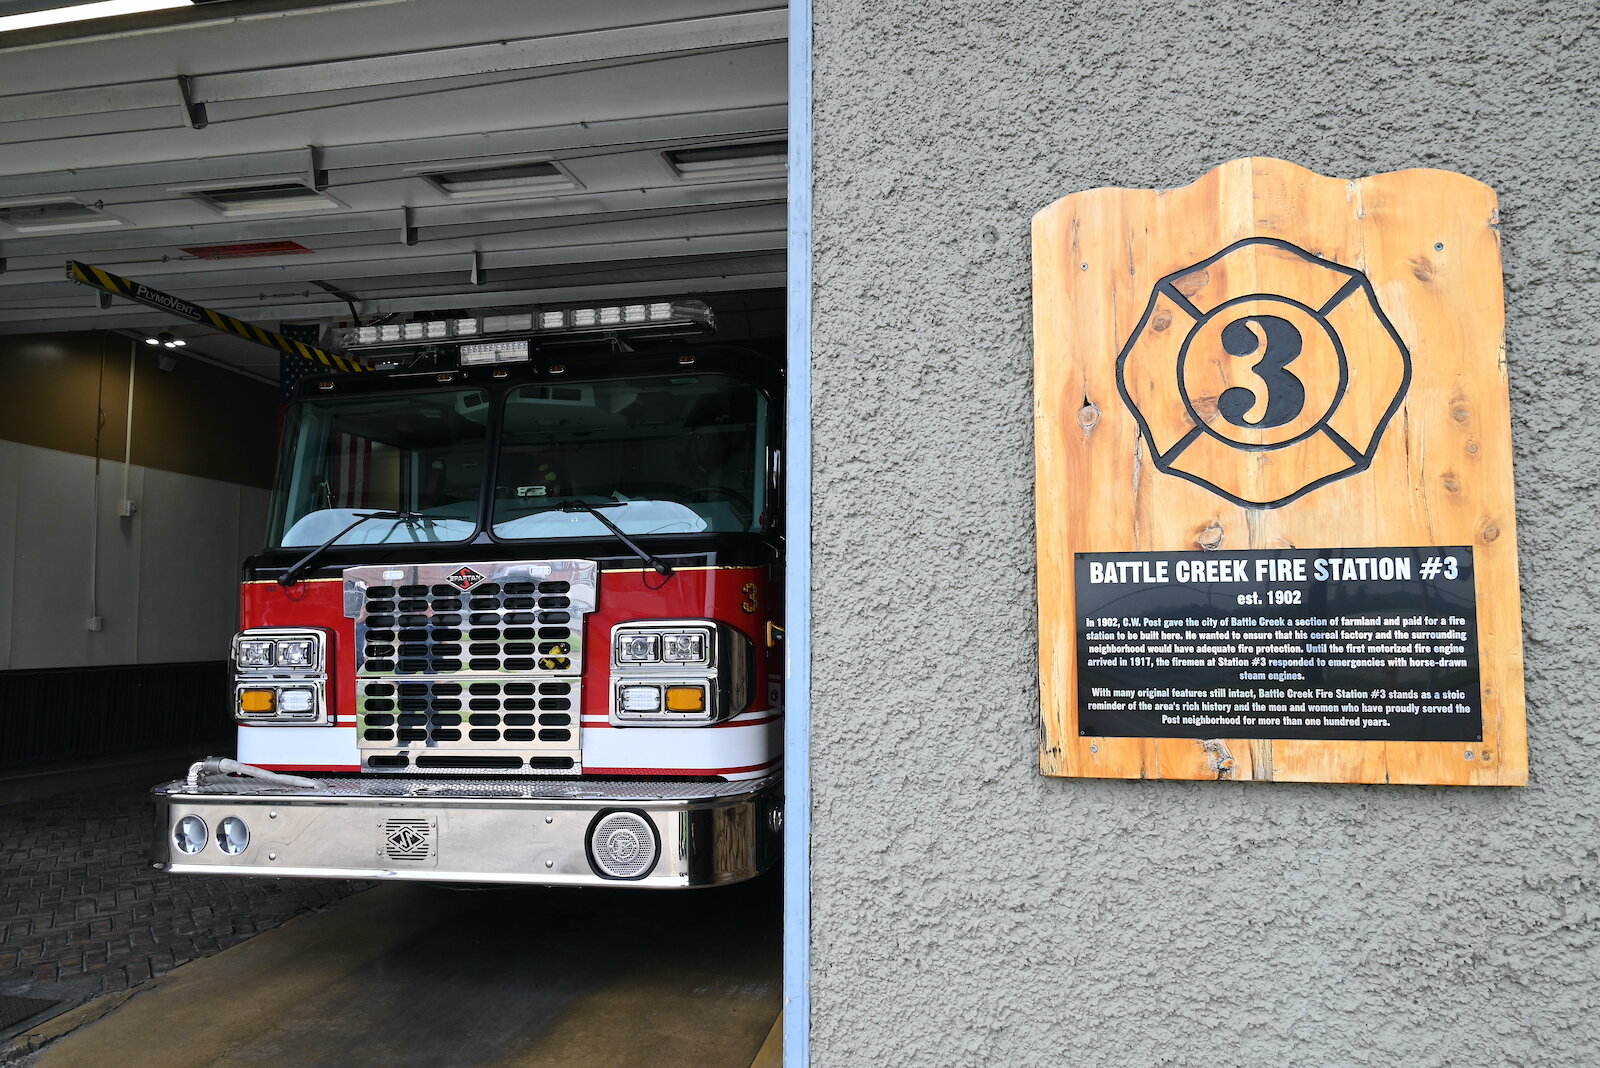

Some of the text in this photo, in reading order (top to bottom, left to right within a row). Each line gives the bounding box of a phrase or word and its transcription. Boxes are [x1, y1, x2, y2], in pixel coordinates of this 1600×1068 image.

[1218, 315, 1305, 428] 3
[1090, 557, 1458, 584] BATTLE CREEK FIRE STATION #3
[743, 582, 758, 613] 3
[1237, 590, 1301, 606] est. 1902
[1086, 616, 1465, 630] In 1902, C.W. Post gave the city of Battle Creek a section of farmland and paid for a fire
[1086, 630, 1467, 643] station to be built here. He wanted to ensure that his cereal factory and the surrounding
[1089, 644, 1464, 656] neighborhood would have adequate fire protection. Until the first motorized fire engine
[1088, 657, 1467, 670] arrived in 1917, the firemen at Station #3 responded to emergencies with horse-drawn
[1239, 672, 1304, 683] steam engines.
[1092, 688, 1465, 701] With many original features still intact, Battle Creek Fire Station #3 stands as a stoic
[1088, 702, 1125, 711] reminder
[1128, 702, 1136, 712] of
[1138, 702, 1152, 712] the
[1154, 702, 1180, 712] area's
[1182, 702, 1199, 712] rich
[1202, 702, 1231, 715] history
[1234, 703, 1249, 712] and
[1252, 703, 1266, 712] the
[1289, 703, 1305, 713] and
[1308, 705, 1339, 713] women
[1341, 703, 1359, 713] who
[1362, 703, 1383, 713] have
[1385, 704, 1419, 716] proudly
[1422, 704, 1453, 714] served
[1455, 704, 1470, 714] the
[1162, 715, 1180, 725] Post
[1182, 716, 1240, 728] neighborhood
[1243, 716, 1256, 726] for
[1258, 718, 1280, 726] more
[1282, 716, 1302, 726] than
[1323, 717, 1360, 727] hundred
[1362, 719, 1390, 729] years.
